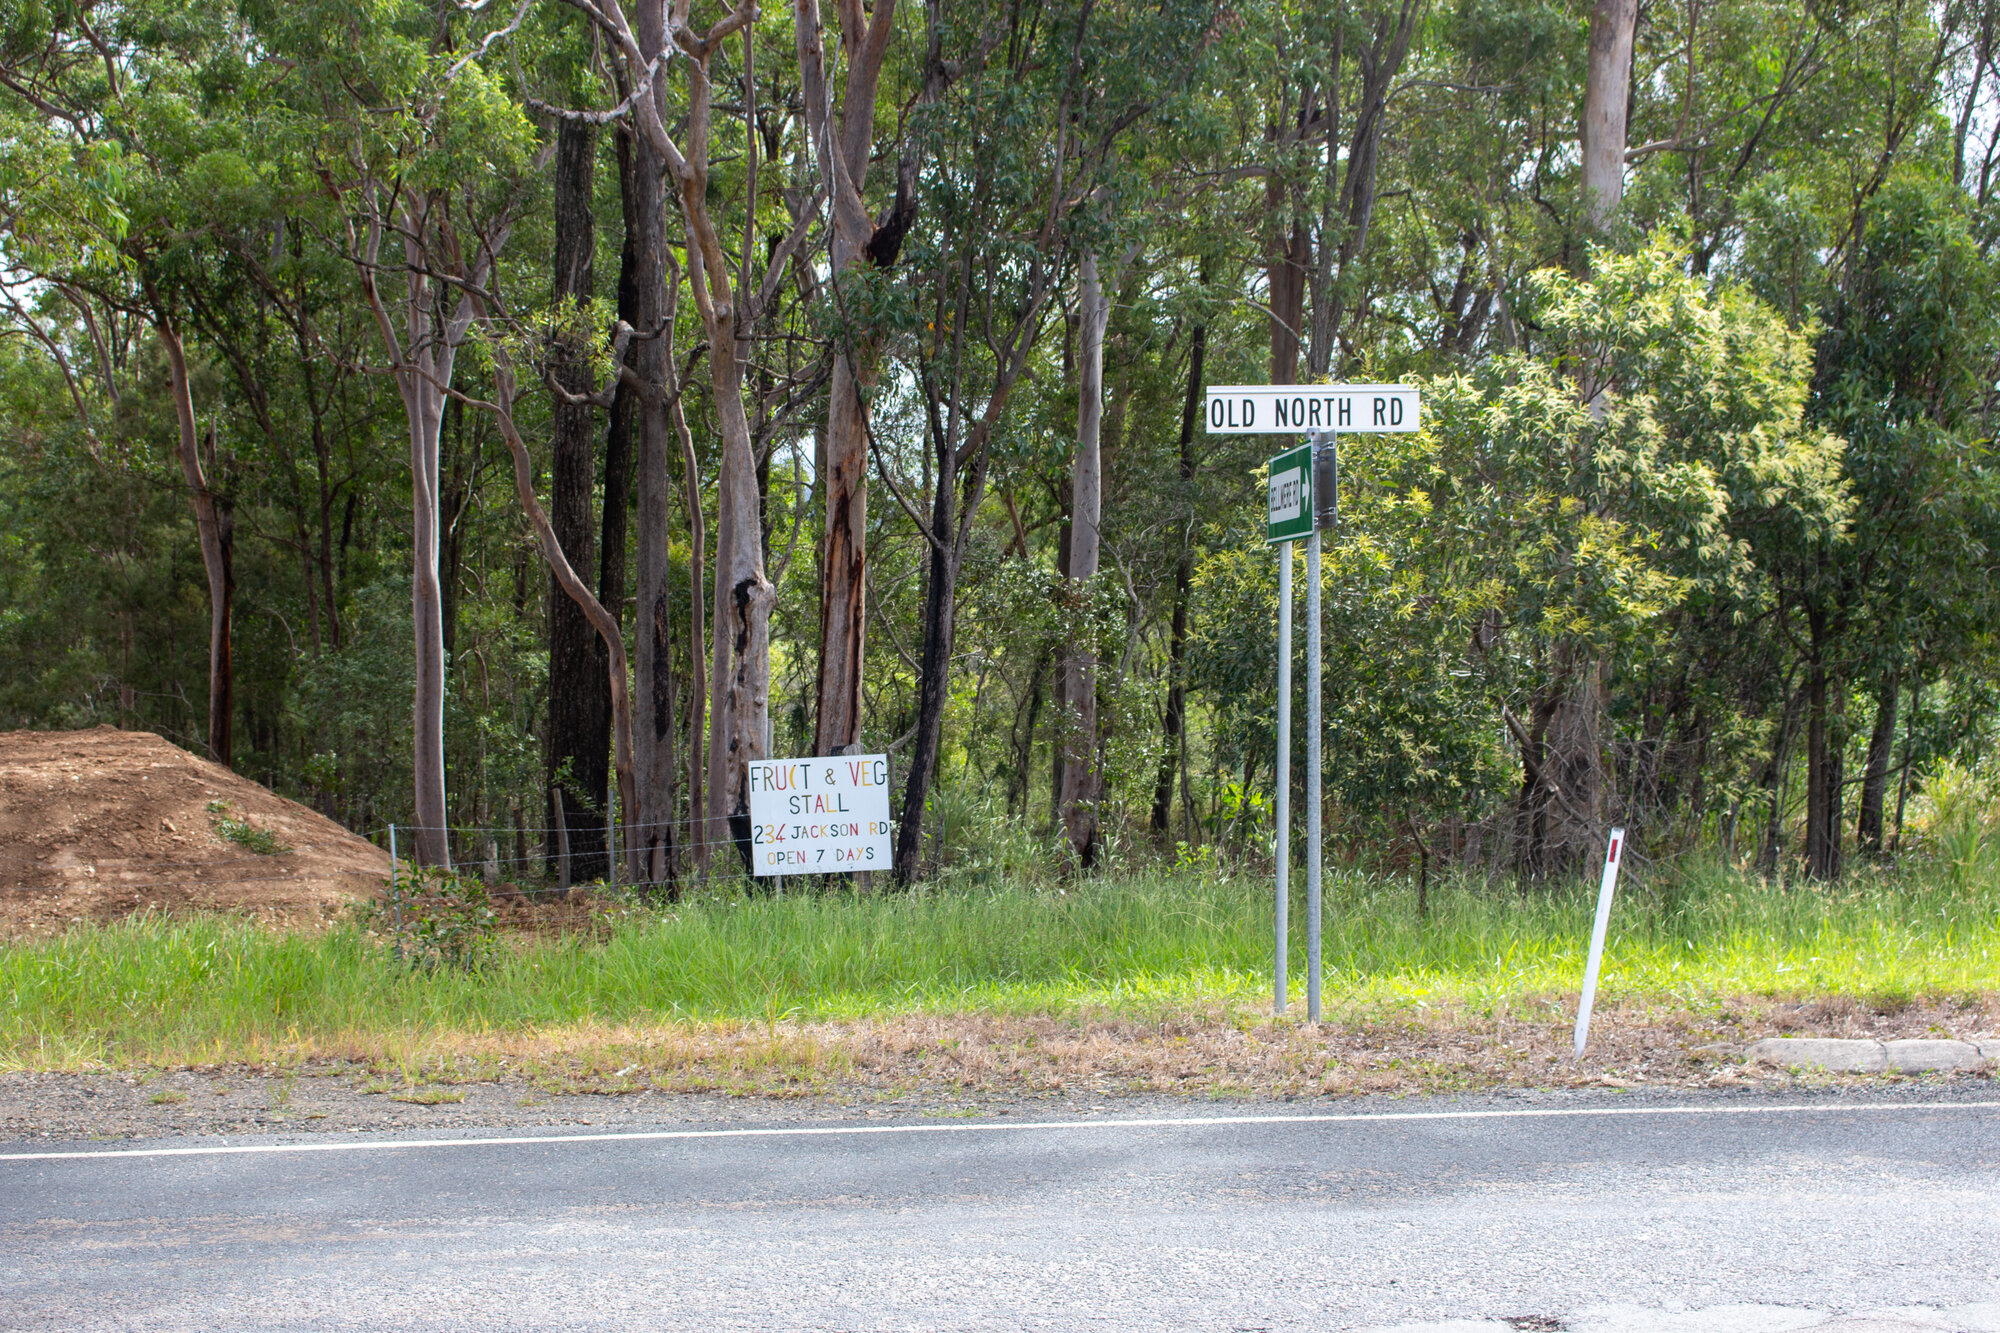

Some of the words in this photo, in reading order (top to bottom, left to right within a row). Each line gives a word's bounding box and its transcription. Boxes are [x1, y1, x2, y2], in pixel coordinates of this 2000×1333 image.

[1211, 398, 1255, 428] OLD
[1275, 397, 1351, 427] NORTH
[1373, 397, 1403, 426] RD
[824, 767, 836, 786] &
[849, 760, 888, 787] VEG
[789, 793, 850, 815] STALL
[753, 823, 786, 845] 234
[791, 822, 859, 840] JACKSON
[869, 821, 888, 835] RD
[767, 850, 806, 865] OPEN
[816, 849, 825, 863] 7
[836, 846, 874, 862] DAYS
